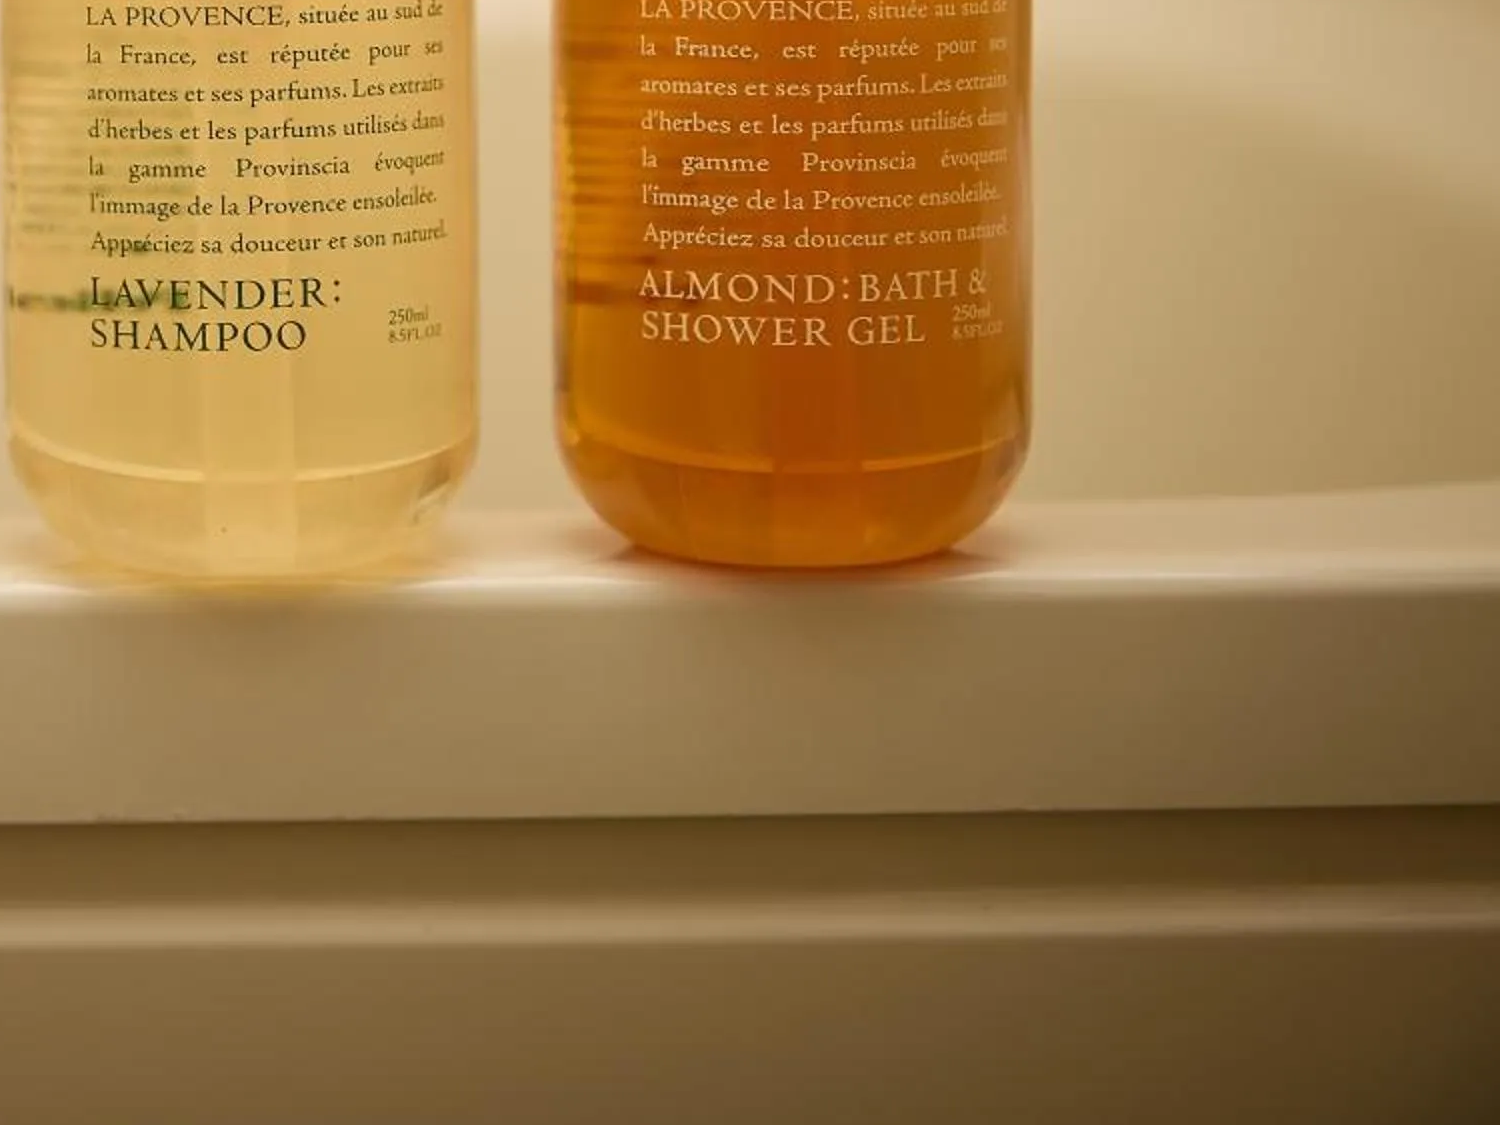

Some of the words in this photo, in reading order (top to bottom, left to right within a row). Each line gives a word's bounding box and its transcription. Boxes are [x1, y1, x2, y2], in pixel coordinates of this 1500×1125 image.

[86, 6, 117, 26] LA
[125, 5, 290, 29] PROVENCE,
[298, 4, 359, 24] située
[366, 6, 389, 22] au
[395, 0, 423, 19] sud
[640, 0, 670, 19] LA
[680, 0, 860, 23] PROVENCE,
[868, 0, 927, 20] située
[934, 3, 956, 17] au
[86, 43, 101, 64] la
[120, 45, 196, 67] France,
[218, 48, 247, 64] est
[271, 43, 350, 68] réputée
[369, 41, 411, 64] pour
[641, 36, 656, 57] la
[675, 37, 759, 61] France,
[783, 42, 816, 58] est
[839, 37, 919, 61] réputée
[937, 38, 977, 61] pour
[87, 85, 178, 102] aromates
[185, 86, 205, 102] et
[211, 86, 243, 102] ses
[250, 81, 347, 107] parfums.
[353, 78, 384, 97] Les
[641, 77, 737, 96] aromates
[744, 80, 769, 96] et
[775, 80, 811, 96] ses
[817, 76, 915, 102] parfums.
[920, 75, 951, 93] Les
[88, 118, 173, 140] d'herbes
[180, 123, 200, 139] et
[207, 119, 236, 139] les
[245, 118, 336, 145] parfums
[343, 114, 407, 135] utilisés
[641, 111, 731, 134] d'herbes
[771, 113, 803, 134] les
[811, 114, 904, 140] parfums
[910, 111, 972, 132] utilisés
[89, 156, 104, 176] la
[129, 161, 206, 181] gamme
[236, 155, 349, 177] Provinscia
[374, 149, 444, 173] évoquent
[642, 148, 657, 169] la
[682, 153, 769, 175] gamme
[802, 152, 916, 172] Provinscia
[89, 193, 181, 219] l'immage
[187, 195, 212, 215] de
[220, 194, 240, 214] la
[248, 193, 347, 214] Provence
[642, 186, 738, 215] l'immage
[746, 188, 776, 209] de
[783, 187, 804, 209] la
[813, 189, 913, 209] Provence
[91, 231, 194, 257] Appréciez
[200, 238, 223, 254] sa
[231, 232, 322, 253] douceur
[329, 235, 348, 251] et
[354, 232, 386, 248] son
[643, 224, 753, 250] Appréciez
[761, 231, 786, 248] sa
[795, 227, 887, 248] douceur
[895, 228, 914, 244] et
[920, 226, 952, 243] son
[90, 276, 342, 311] LAVENDER:
[968, 269, 986, 293] &
[389, 305, 430, 325] 250ml
[90, 318, 306, 353] SHAMPOO
[642, 312, 830, 347] SHOWER
[847, 314, 925, 345] GEL
